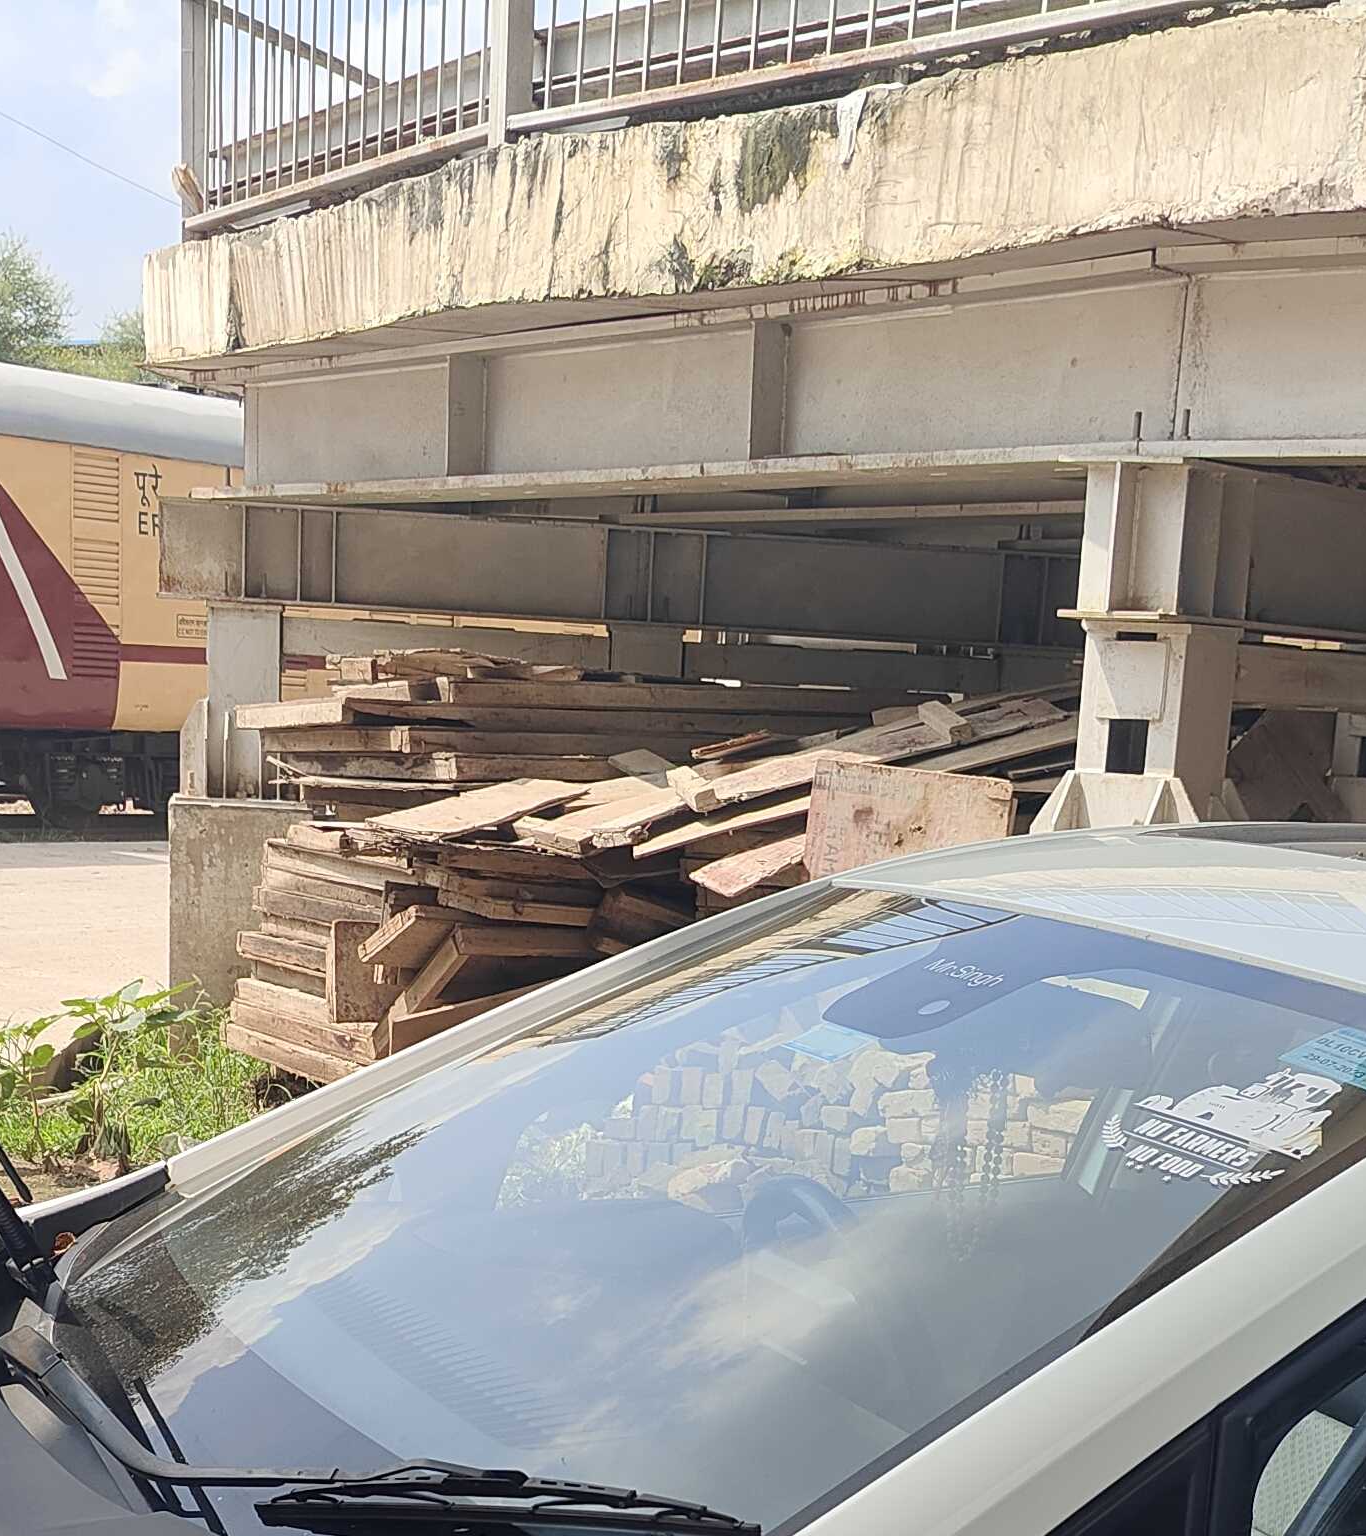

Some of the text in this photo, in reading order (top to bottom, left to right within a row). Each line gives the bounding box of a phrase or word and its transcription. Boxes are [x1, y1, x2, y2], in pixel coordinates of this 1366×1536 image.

[1125, 1144, 1205, 1178] NO FOOD
[1133, 1118, 1259, 1167] NO FARMERS
